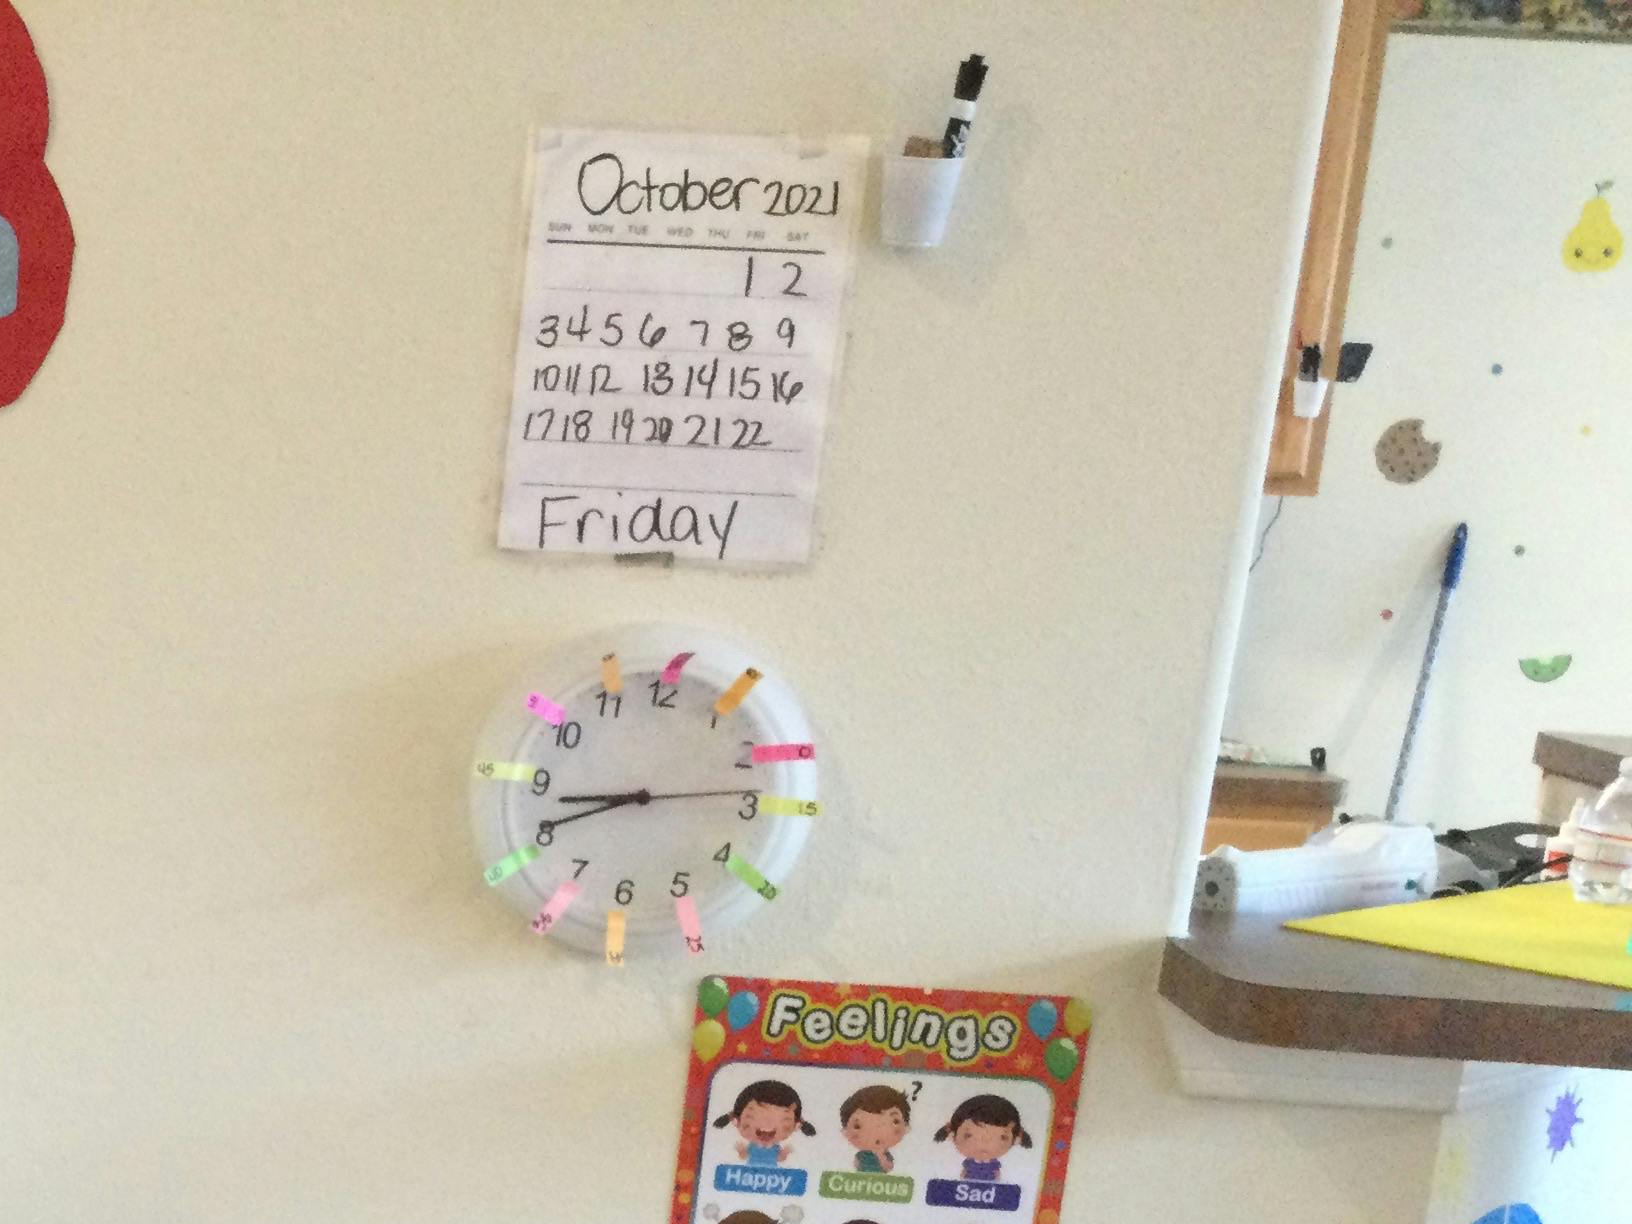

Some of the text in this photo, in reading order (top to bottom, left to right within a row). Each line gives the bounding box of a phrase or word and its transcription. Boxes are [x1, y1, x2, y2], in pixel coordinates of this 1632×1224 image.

[578, 153, 839, 216] October 2021
[548, 222, 810, 242] SUN MON TUE WED THU FRI SAT
[744, 256, 808, 297] 1 2
[536, 304, 796, 352] 3 4 5 6 7 8 9
[533, 358, 804, 404] 10 11 12 13 14 15 16
[523, 408, 772, 449] 17 18 19 20 21 22
[536, 490, 738, 560] Friday
[595, 690, 621, 718] 11
[648, 679, 678, 709] 12
[552, 721, 581, 749] 10
[532, 768, 550, 796] 9
[738, 792, 758, 821] 3
[536, 820, 555, 846] 8
[712, 842, 731, 862] 4
[572, 859, 589, 879] 7
[615, 880, 635, 905] 6
[670, 872, 690, 897] 5
[767, 994, 1017, 1060] Feelings
[725, 1169, 792, 1193] Happy
[828, 1174, 909, 1198] Curious
[955, 1184, 996, 1204] Sad
